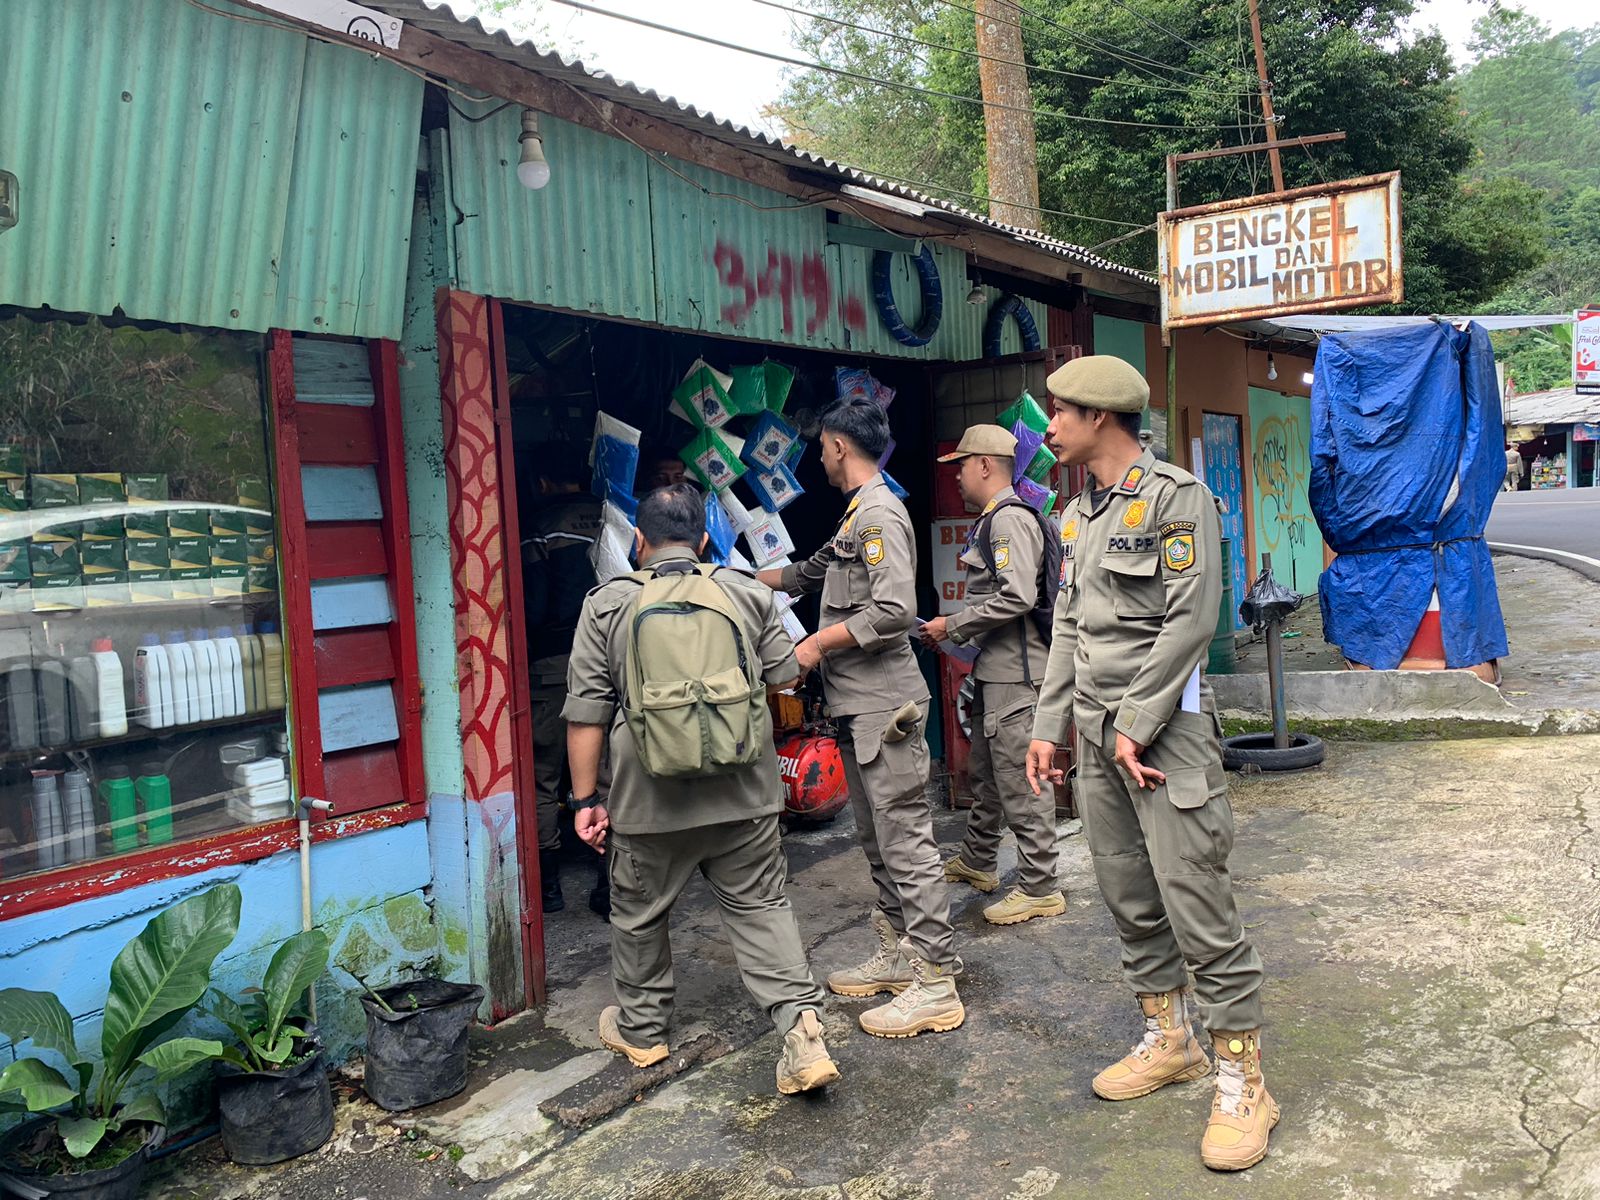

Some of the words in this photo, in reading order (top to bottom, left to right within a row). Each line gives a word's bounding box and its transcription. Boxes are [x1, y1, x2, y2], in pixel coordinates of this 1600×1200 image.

[1193, 202, 1359, 256] BENGKEL
[1275, 241, 1326, 270] DAN
[1173, 255, 1269, 298] MOBIL
[1271, 258, 1387, 304] MOTOR
[940, 525, 972, 545] BE
[1108, 537, 1131, 550] POL
[1134, 538, 1154, 550] PP
